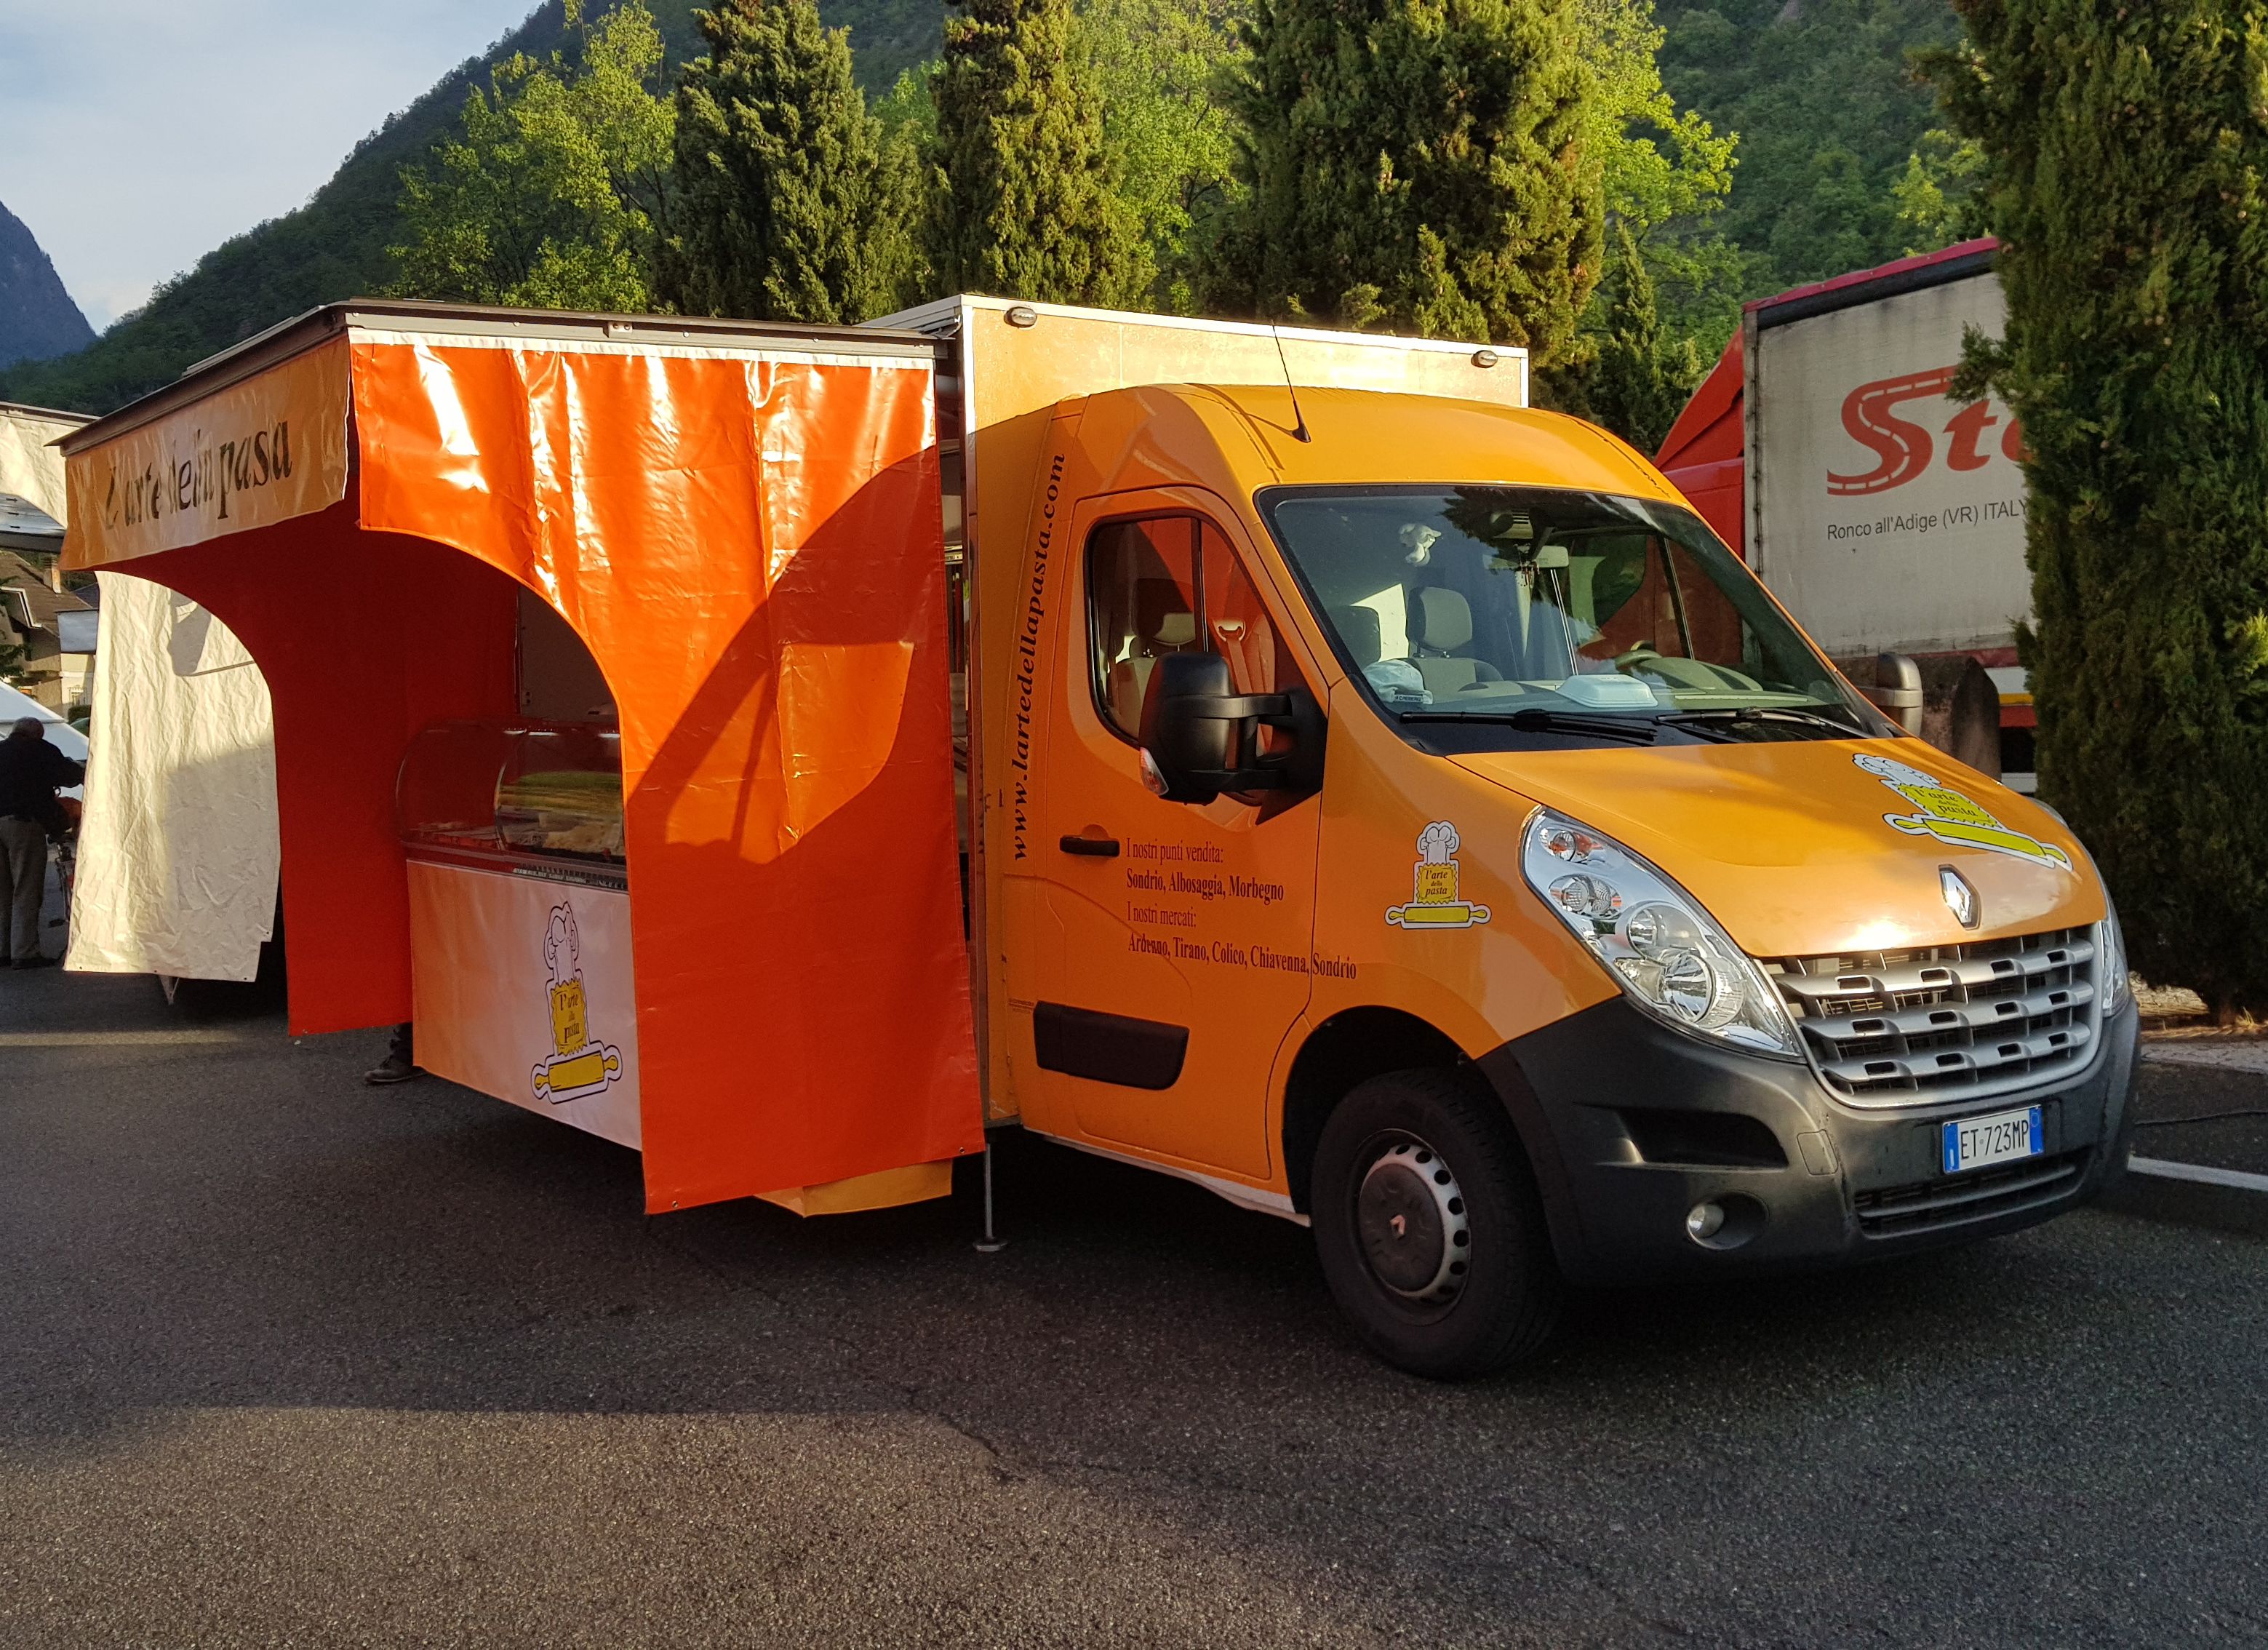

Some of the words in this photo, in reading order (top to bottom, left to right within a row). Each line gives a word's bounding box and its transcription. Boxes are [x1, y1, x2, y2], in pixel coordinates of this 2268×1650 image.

[1827, 524, 1872, 541] Ronco
[1875, 512, 1938, 533] all'Adige
[1943, 505, 1978, 530] (VR)
[1984, 499, 2028, 521] ITALY
[1013, 453, 1065, 861] www.lartedellapasta.com
[1937, 805, 1978, 817] pasta
[1126, 837, 1130, 858] I
[1133, 839, 1157, 859] nostri
[1160, 840, 1183, 865] punti
[1186, 841, 1223, 864] vendita:
[1127, 868, 1166, 892] Sondrio,
[1168, 872, 1226, 901] Albosaggia,
[1229, 875, 1284, 905] Morbegno
[1425, 869, 1448, 880] l'arte
[1425, 887, 1448, 898] pasta
[1127, 901, 1131, 921] I
[1133, 903, 1157, 924] nostri
[1160, 906, 1197, 928] mercati:
[1128, 932, 1170, 960] Ardenno,
[1173, 936, 1210, 965] Tirano,
[1212, 941, 1247, 970] Colico,
[1250, 945, 1310, 977] Chiavenna,
[1312, 952, 1357, 979] Sondrio
